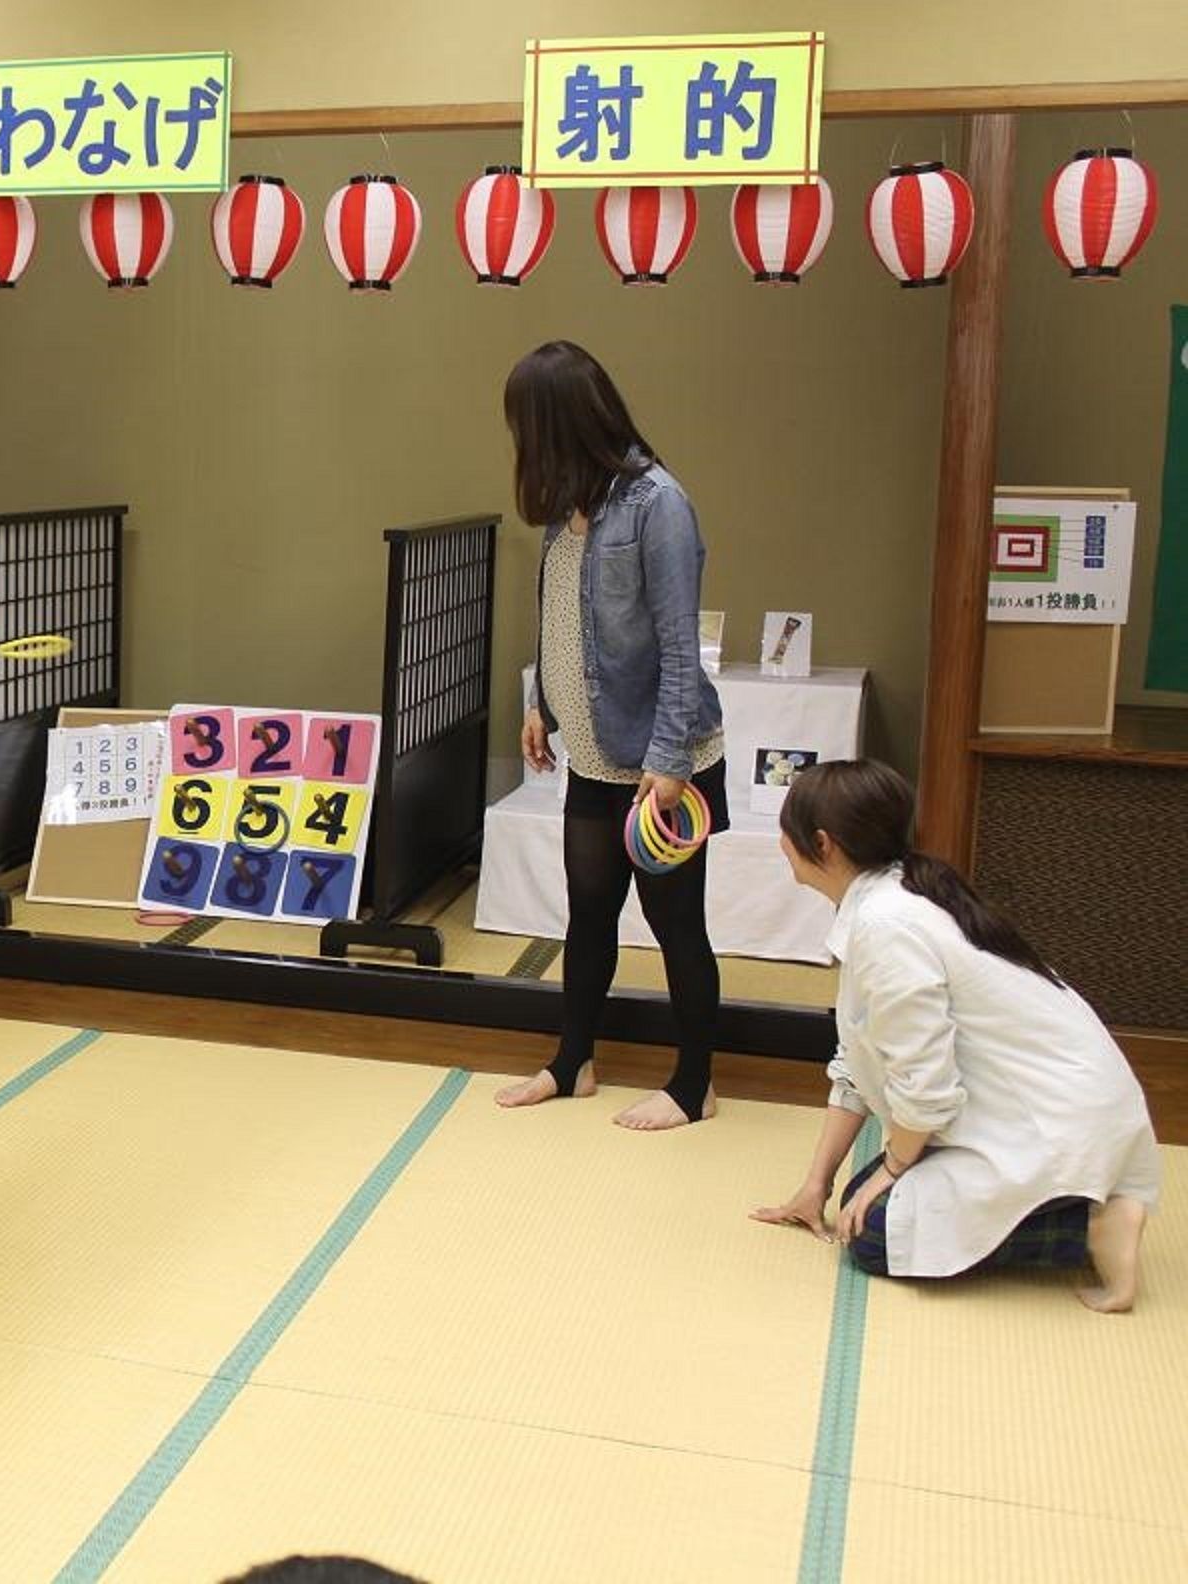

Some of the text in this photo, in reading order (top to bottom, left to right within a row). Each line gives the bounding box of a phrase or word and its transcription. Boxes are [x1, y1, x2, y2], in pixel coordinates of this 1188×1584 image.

[556, 60, 777, 162] 射的
[72, 757, 137, 774] 4 5 6
[75, 737, 137, 755] 1 2 3
[183, 716, 225, 768] 3
[250, 720, 291, 773] 2
[324, 724, 352, 777] 1
[75, 777, 137, 797] 7 8 9
[172, 779, 213, 830] 6
[238, 785, 281, 839] 5
[305, 792, 350, 845] 4
[159, 845, 346, 911] 9 8 7
